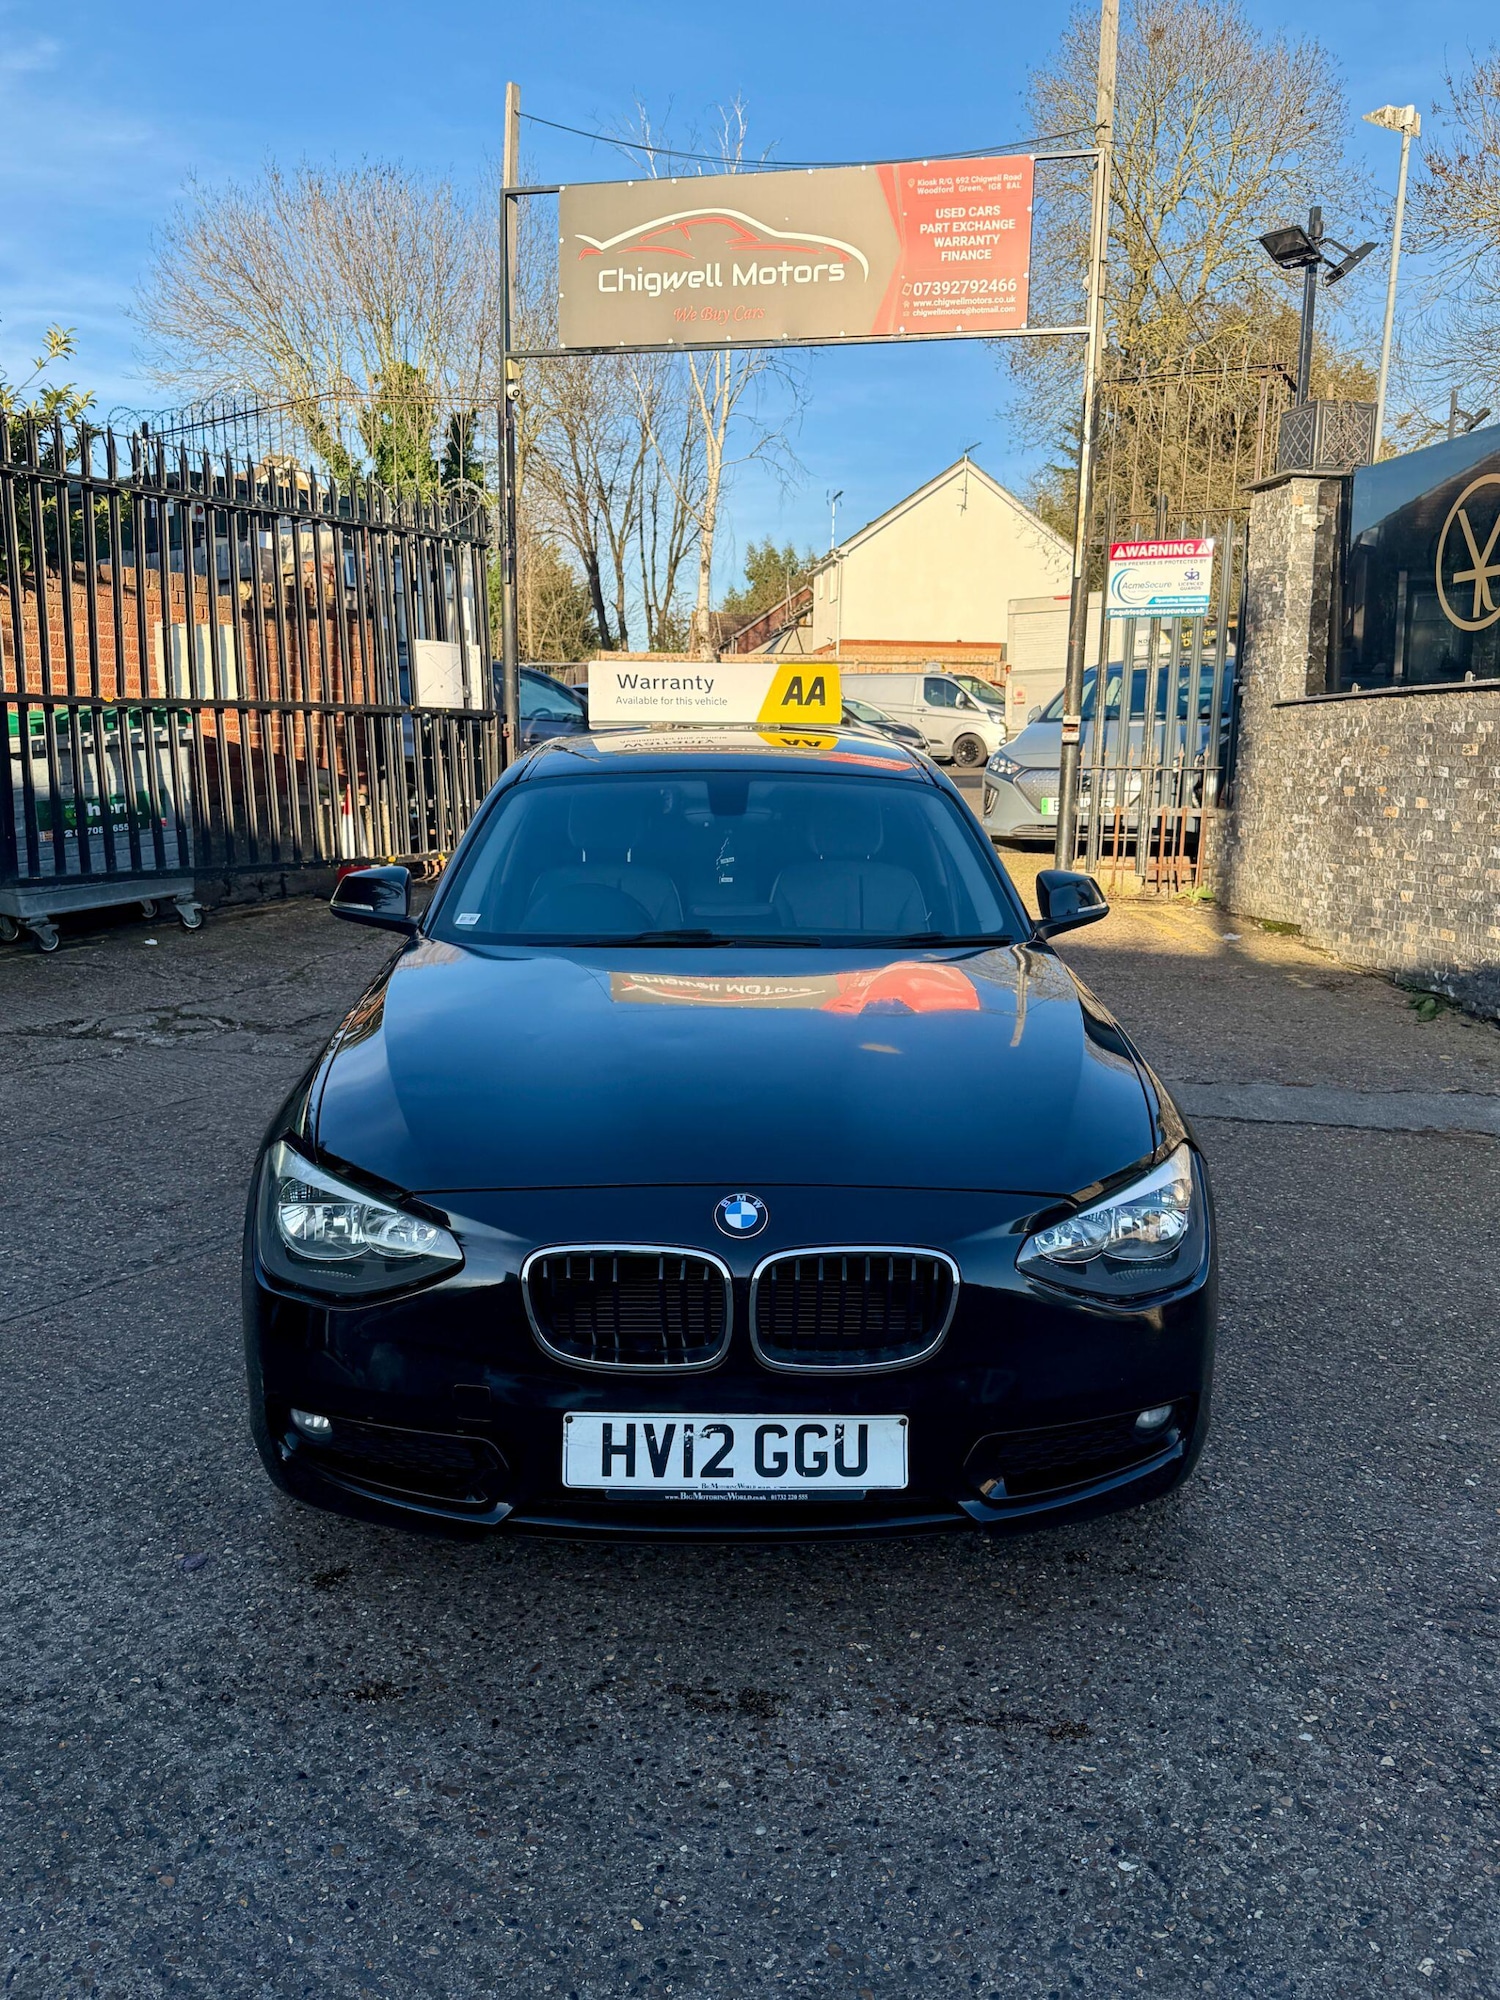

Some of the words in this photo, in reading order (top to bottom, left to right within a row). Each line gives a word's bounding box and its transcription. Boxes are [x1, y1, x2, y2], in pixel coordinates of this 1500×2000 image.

[956, 176, 969, 184] 692
[971, 174, 1001, 185] Chigwell
[1003, 173, 1022, 181] Road
[917, 186, 954, 195] Woodford
[988, 182, 1001, 190] IG8
[1006, 181, 1021, 189] 8AL
[935, 207, 966, 219] USED
[968, 205, 1001, 216] CARS
[920, 222, 950, 234] PART
[952, 219, 1016, 232] EXCHANGE
[934, 234, 1001, 248] WARRANTY
[941, 249, 992, 261] FINANCE
[598, 263, 723, 297] Chigwell
[732, 261, 846, 287] Motors
[913, 278, 1017, 296] 07392792466
[912, 295, 1016, 307] www.chigwellmotors.co.uk
[673, 305, 698, 322] We
[700, 306, 730, 325] Buy
[732, 304, 765, 321] Cars
[912, 305, 1016, 318] chigwellmotors@hotmail.com
[1125, 543, 1195, 558] WARNING
[1121, 581, 1172, 590] AcmeSecure
[616, 674, 715, 694] Warranty
[781, 676, 826, 706] AA
[616, 696, 659, 706] Available
[660, 696, 674, 706] for
[676, 696, 693, 706] this
[695, 697, 728, 706] vehicle
[720, 1195, 763, 1209] BMW
[602, 1423, 734, 1478] HV12
[754, 1424, 869, 1478] GGU
